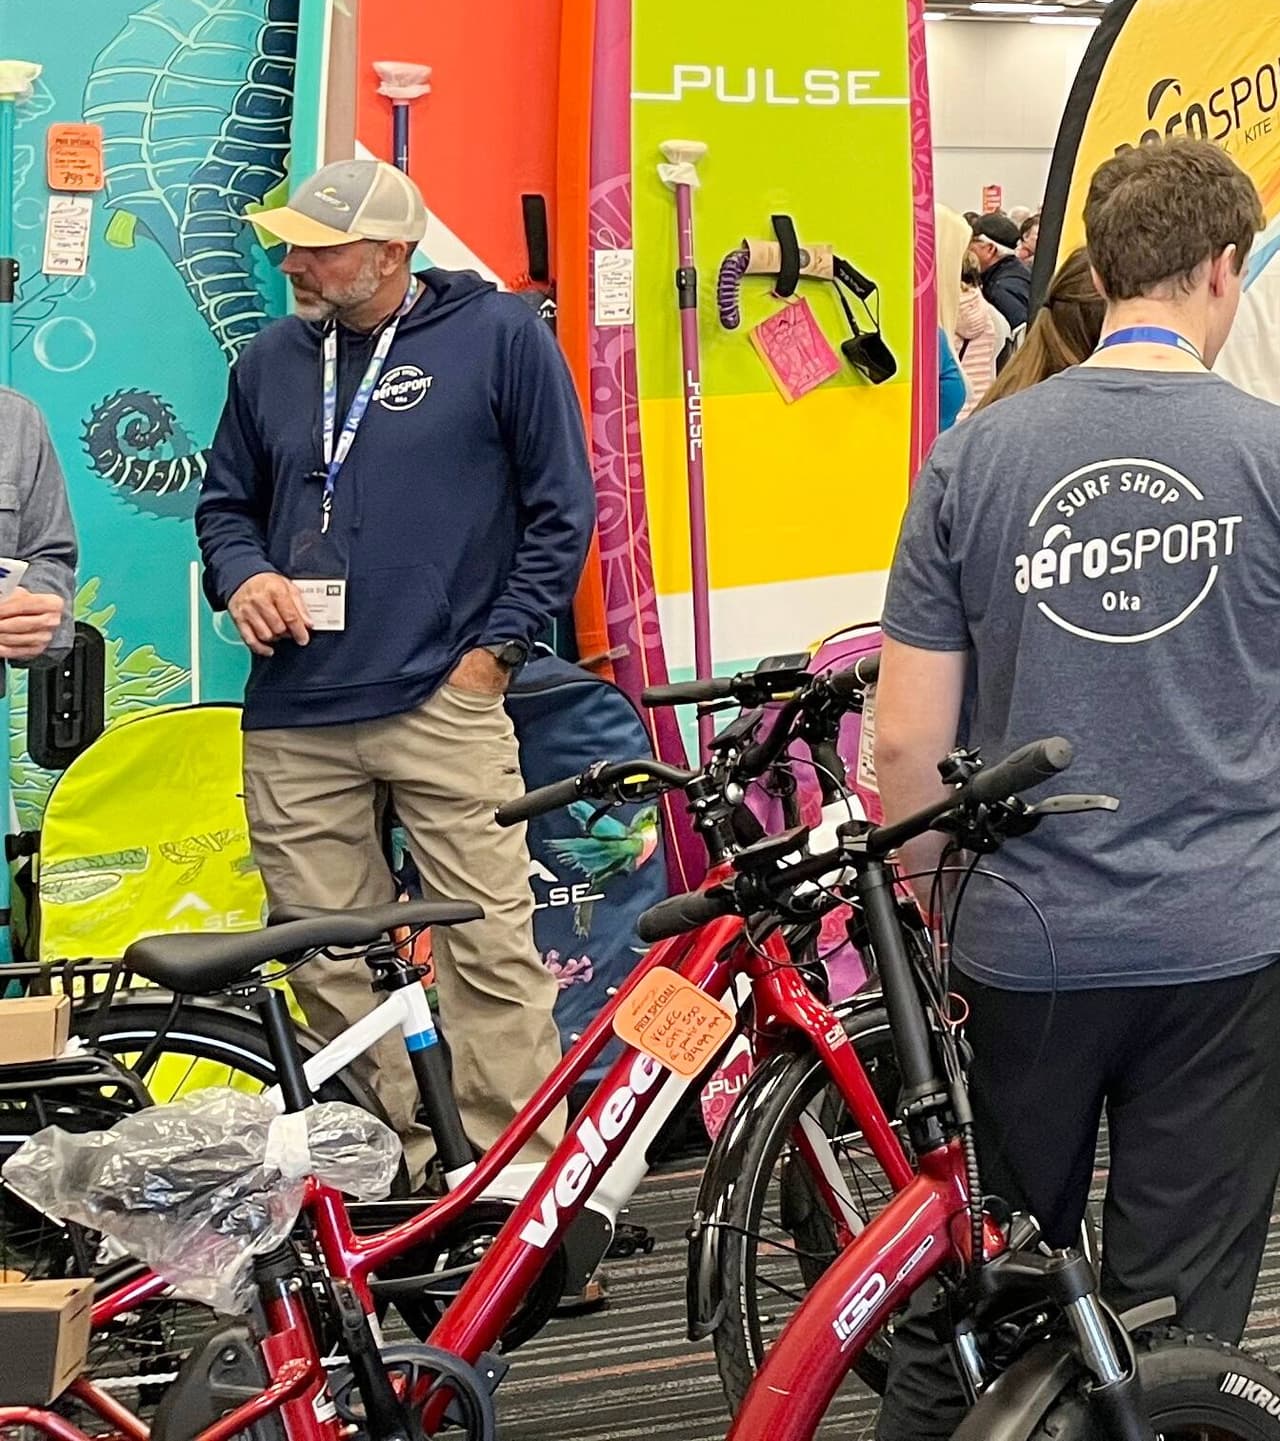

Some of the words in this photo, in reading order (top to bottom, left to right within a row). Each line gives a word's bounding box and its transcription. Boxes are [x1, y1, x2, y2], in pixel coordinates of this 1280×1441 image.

[631, 64, 909, 105] PULSE
[1244, 116, 1273, 144] KITE
[1056, 474, 1111, 518] SURF
[1119, 471, 1181, 505] SHOP
[1101, 590, 1142, 612] Oka
